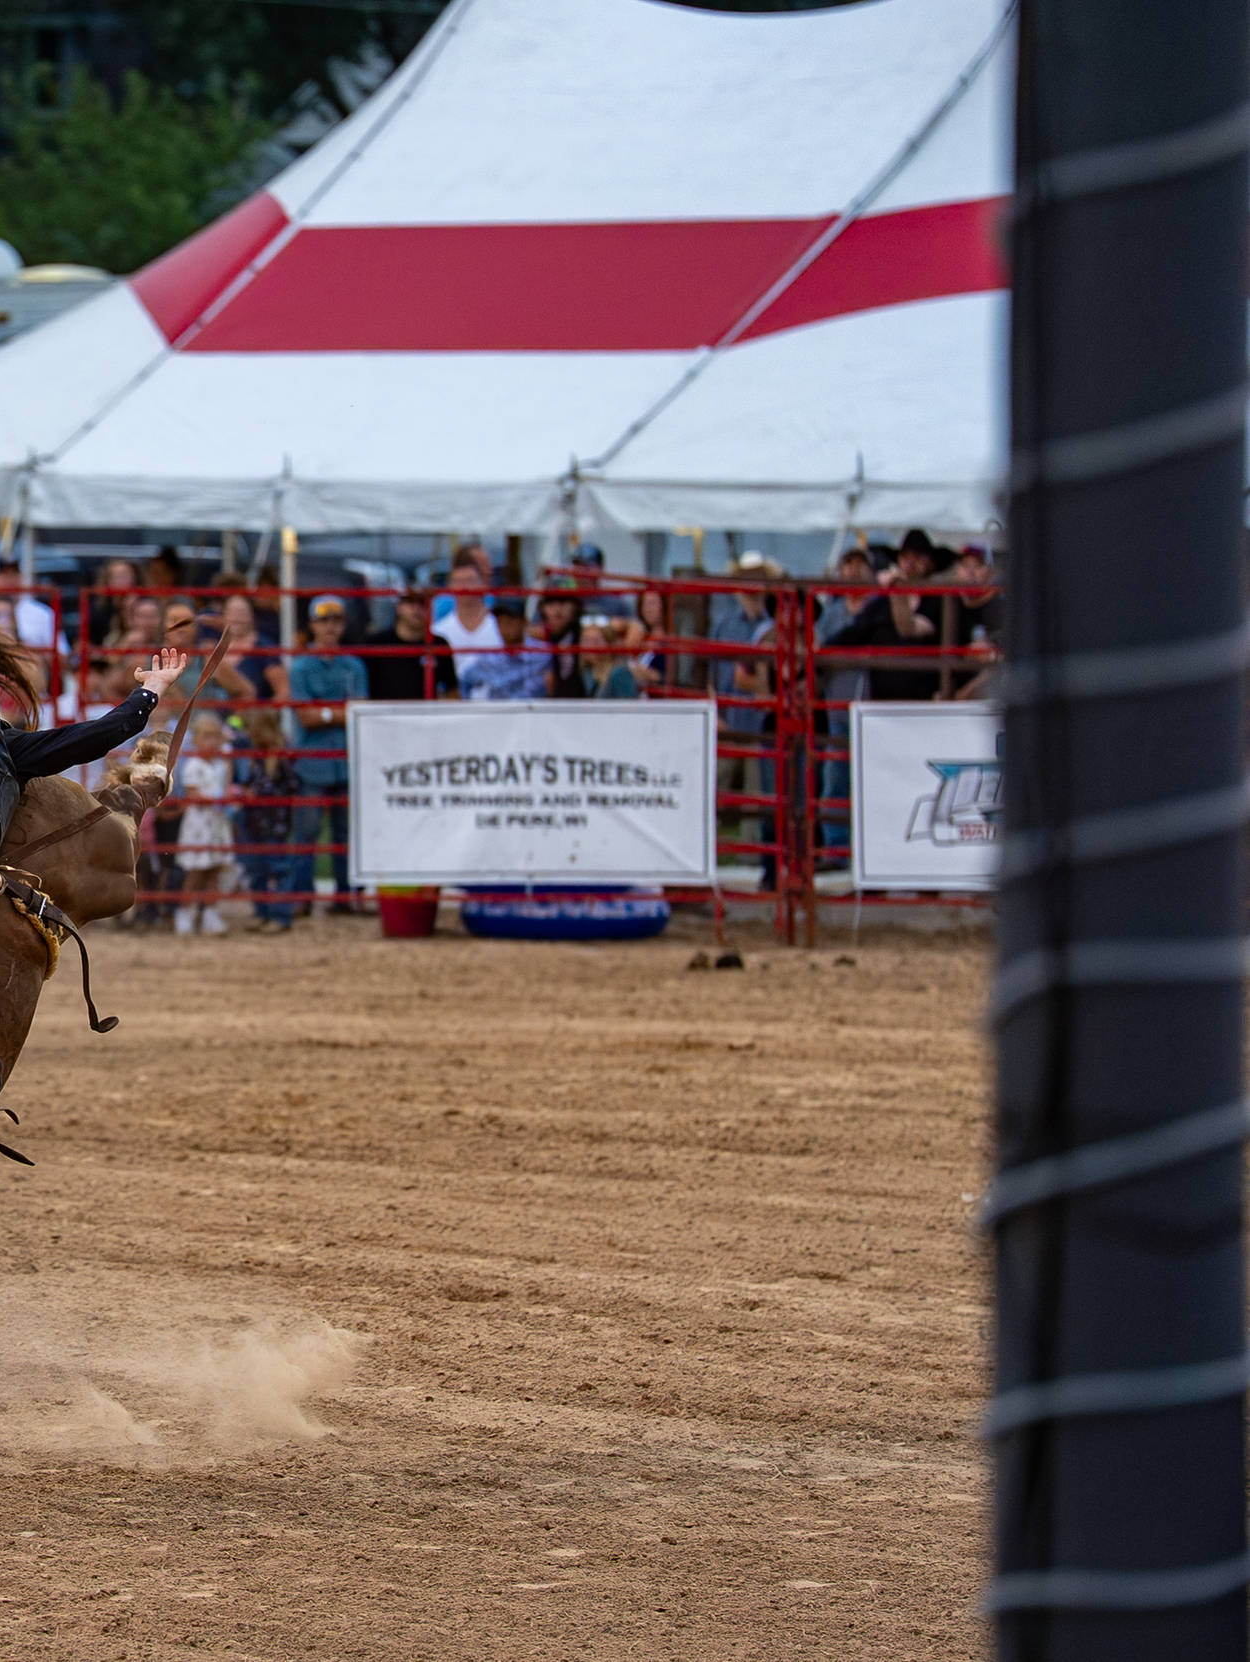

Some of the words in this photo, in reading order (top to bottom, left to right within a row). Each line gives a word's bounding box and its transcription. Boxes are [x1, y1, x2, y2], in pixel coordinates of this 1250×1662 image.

[381, 754, 559, 787] YESTERDAY'S
[565, 757, 648, 786] TREES
[541, 795, 583, 809] AND
[587, 794, 679, 810] REMOVAL
